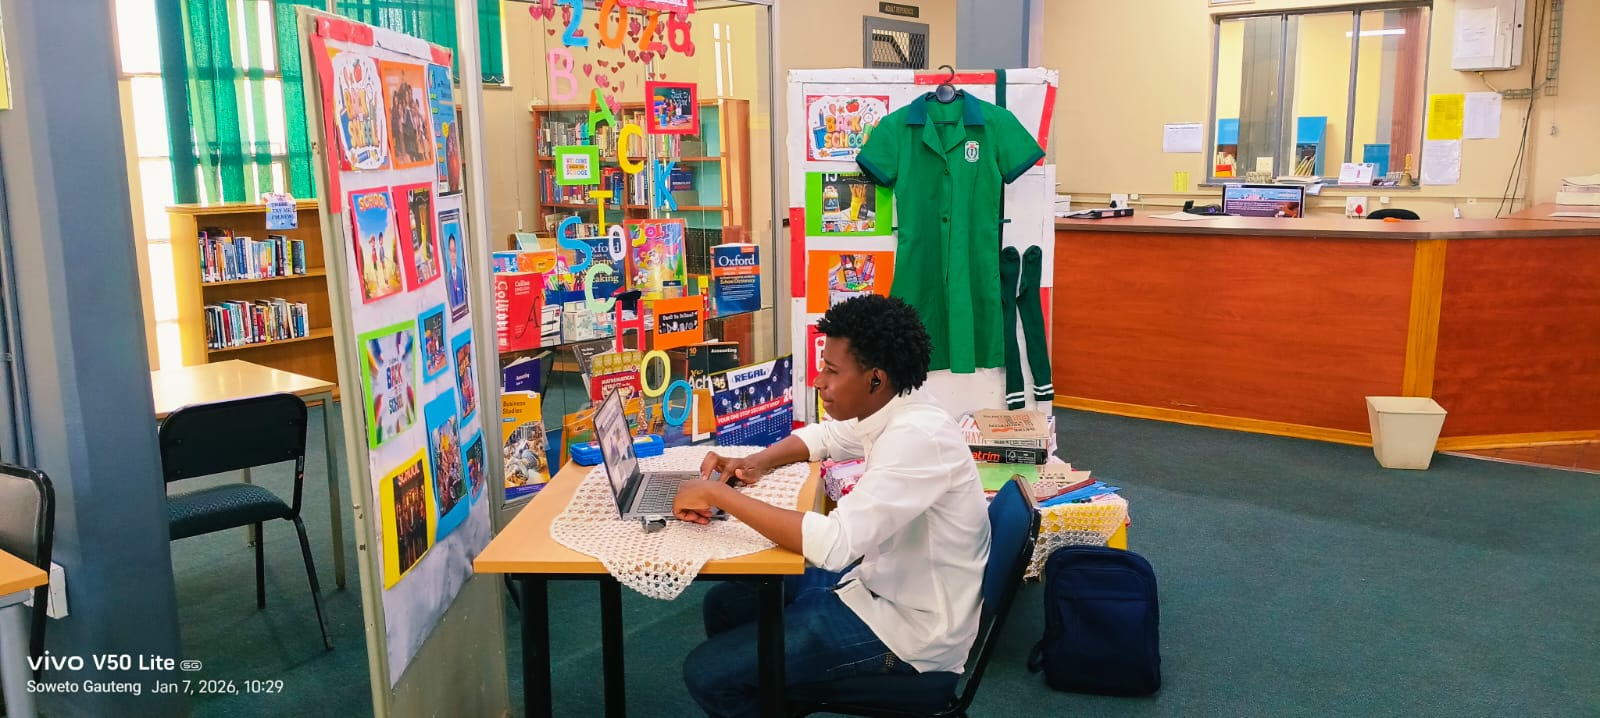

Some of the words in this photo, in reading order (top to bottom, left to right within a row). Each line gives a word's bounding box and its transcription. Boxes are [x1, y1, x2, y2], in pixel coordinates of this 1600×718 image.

[825, 114, 862, 133] BACK
[358, 193, 388, 212] SCHOOL
[718, 254, 756, 266] Oxford
[735, 368, 766, 383] REGAL
